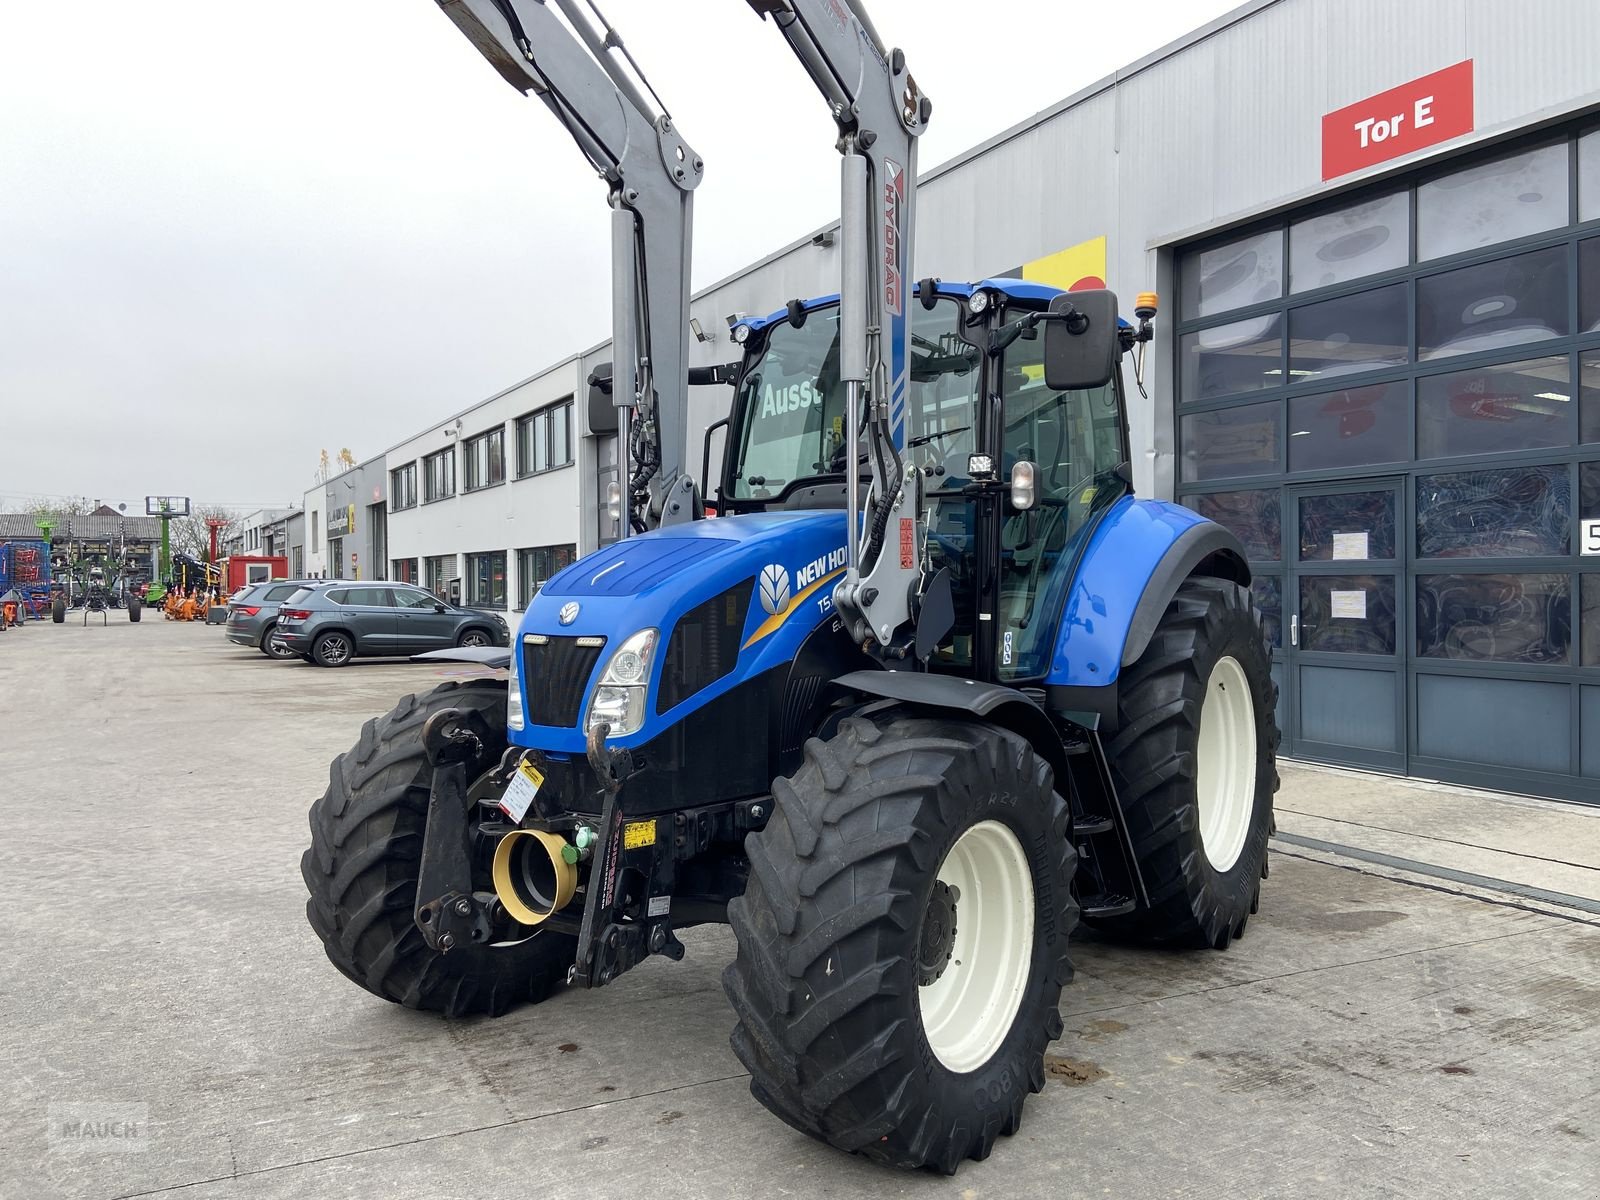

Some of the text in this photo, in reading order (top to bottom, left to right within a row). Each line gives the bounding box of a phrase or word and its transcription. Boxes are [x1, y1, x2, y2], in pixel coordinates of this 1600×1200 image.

[1354, 95, 1435, 148] Tor E
[885, 183, 895, 306] HYDRAC
[796, 556, 827, 591] NEW
